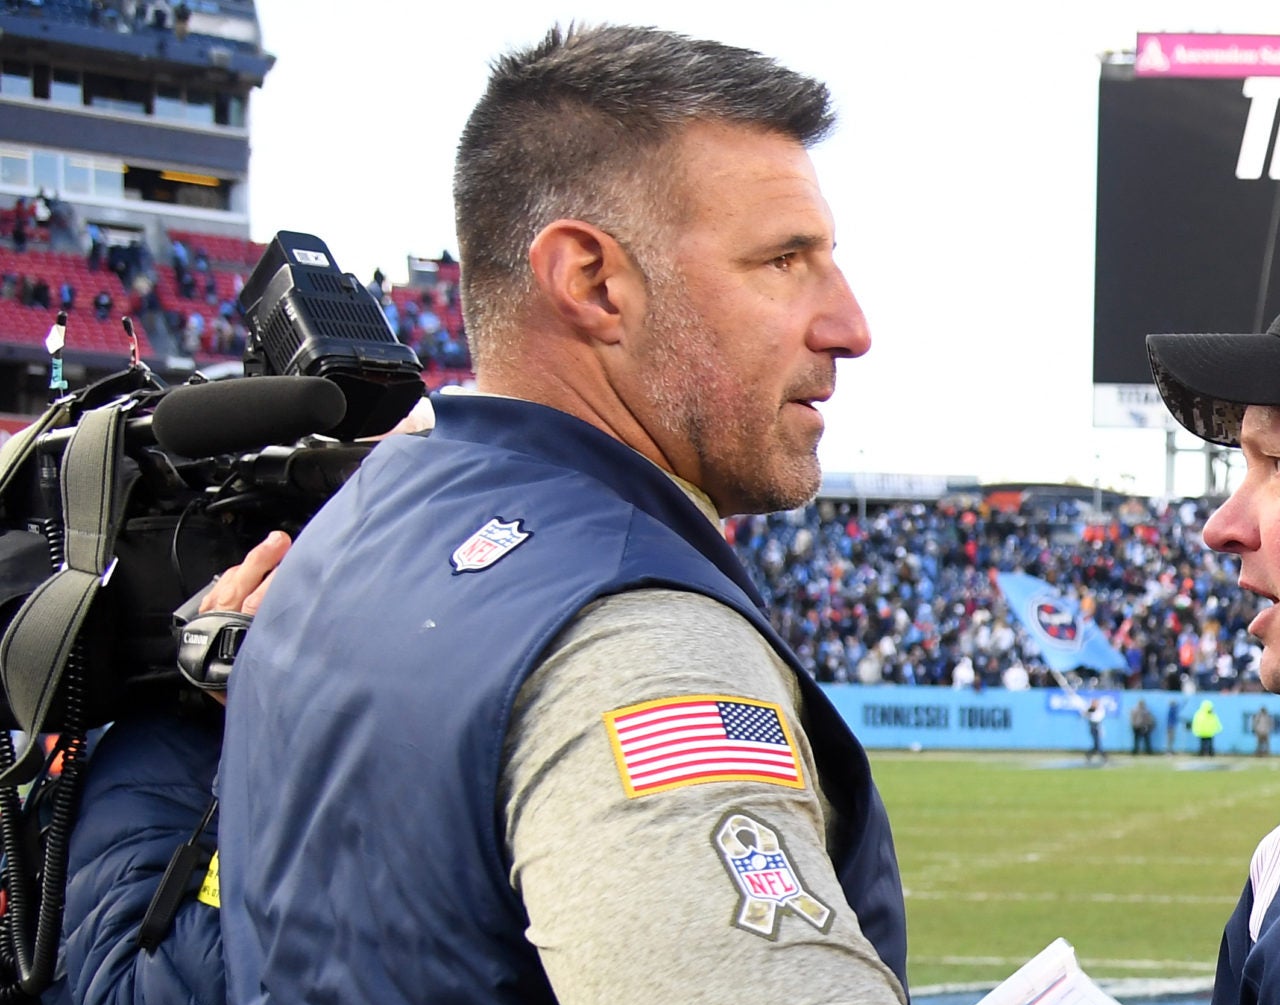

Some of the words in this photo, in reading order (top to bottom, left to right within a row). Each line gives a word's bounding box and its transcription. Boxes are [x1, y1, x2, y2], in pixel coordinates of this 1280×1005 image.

[463, 538, 498, 562] NFL
[184, 632, 208, 645] Canon
[862, 704, 948, 728] TENNESSEE
[959, 706, 1012, 730] TOUGH
[745, 871, 795, 896] NFL
